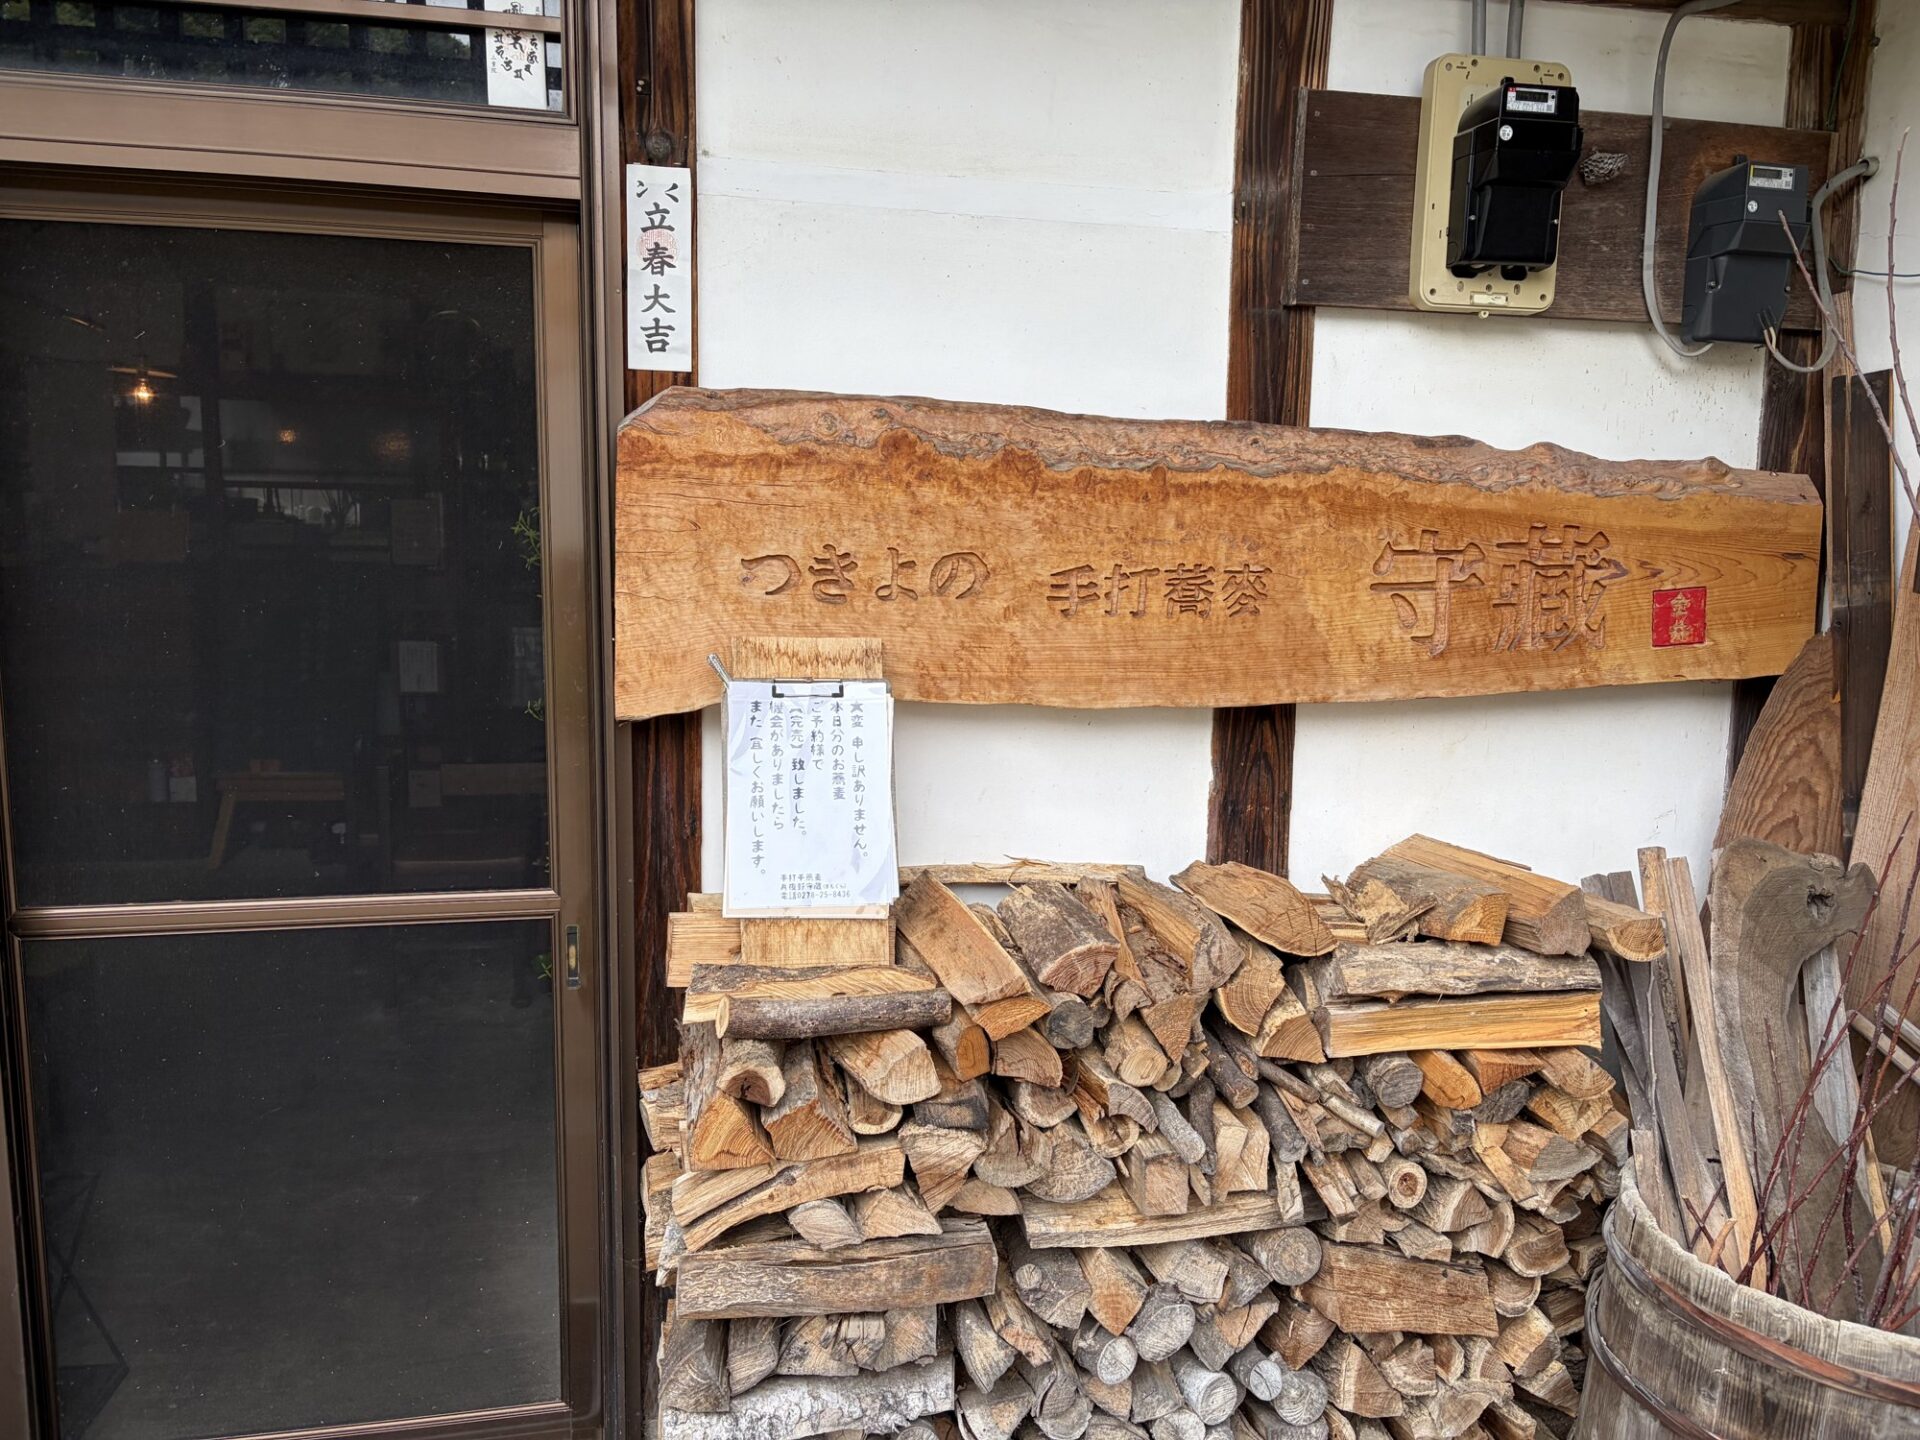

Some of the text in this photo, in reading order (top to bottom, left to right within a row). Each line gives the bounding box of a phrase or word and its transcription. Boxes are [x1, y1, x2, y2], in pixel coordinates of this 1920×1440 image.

[640, 202, 677, 354] 立春大吉
[740, 543, 991, 604] つきよの
[769, 701, 784, 830] 機会がありましたら
